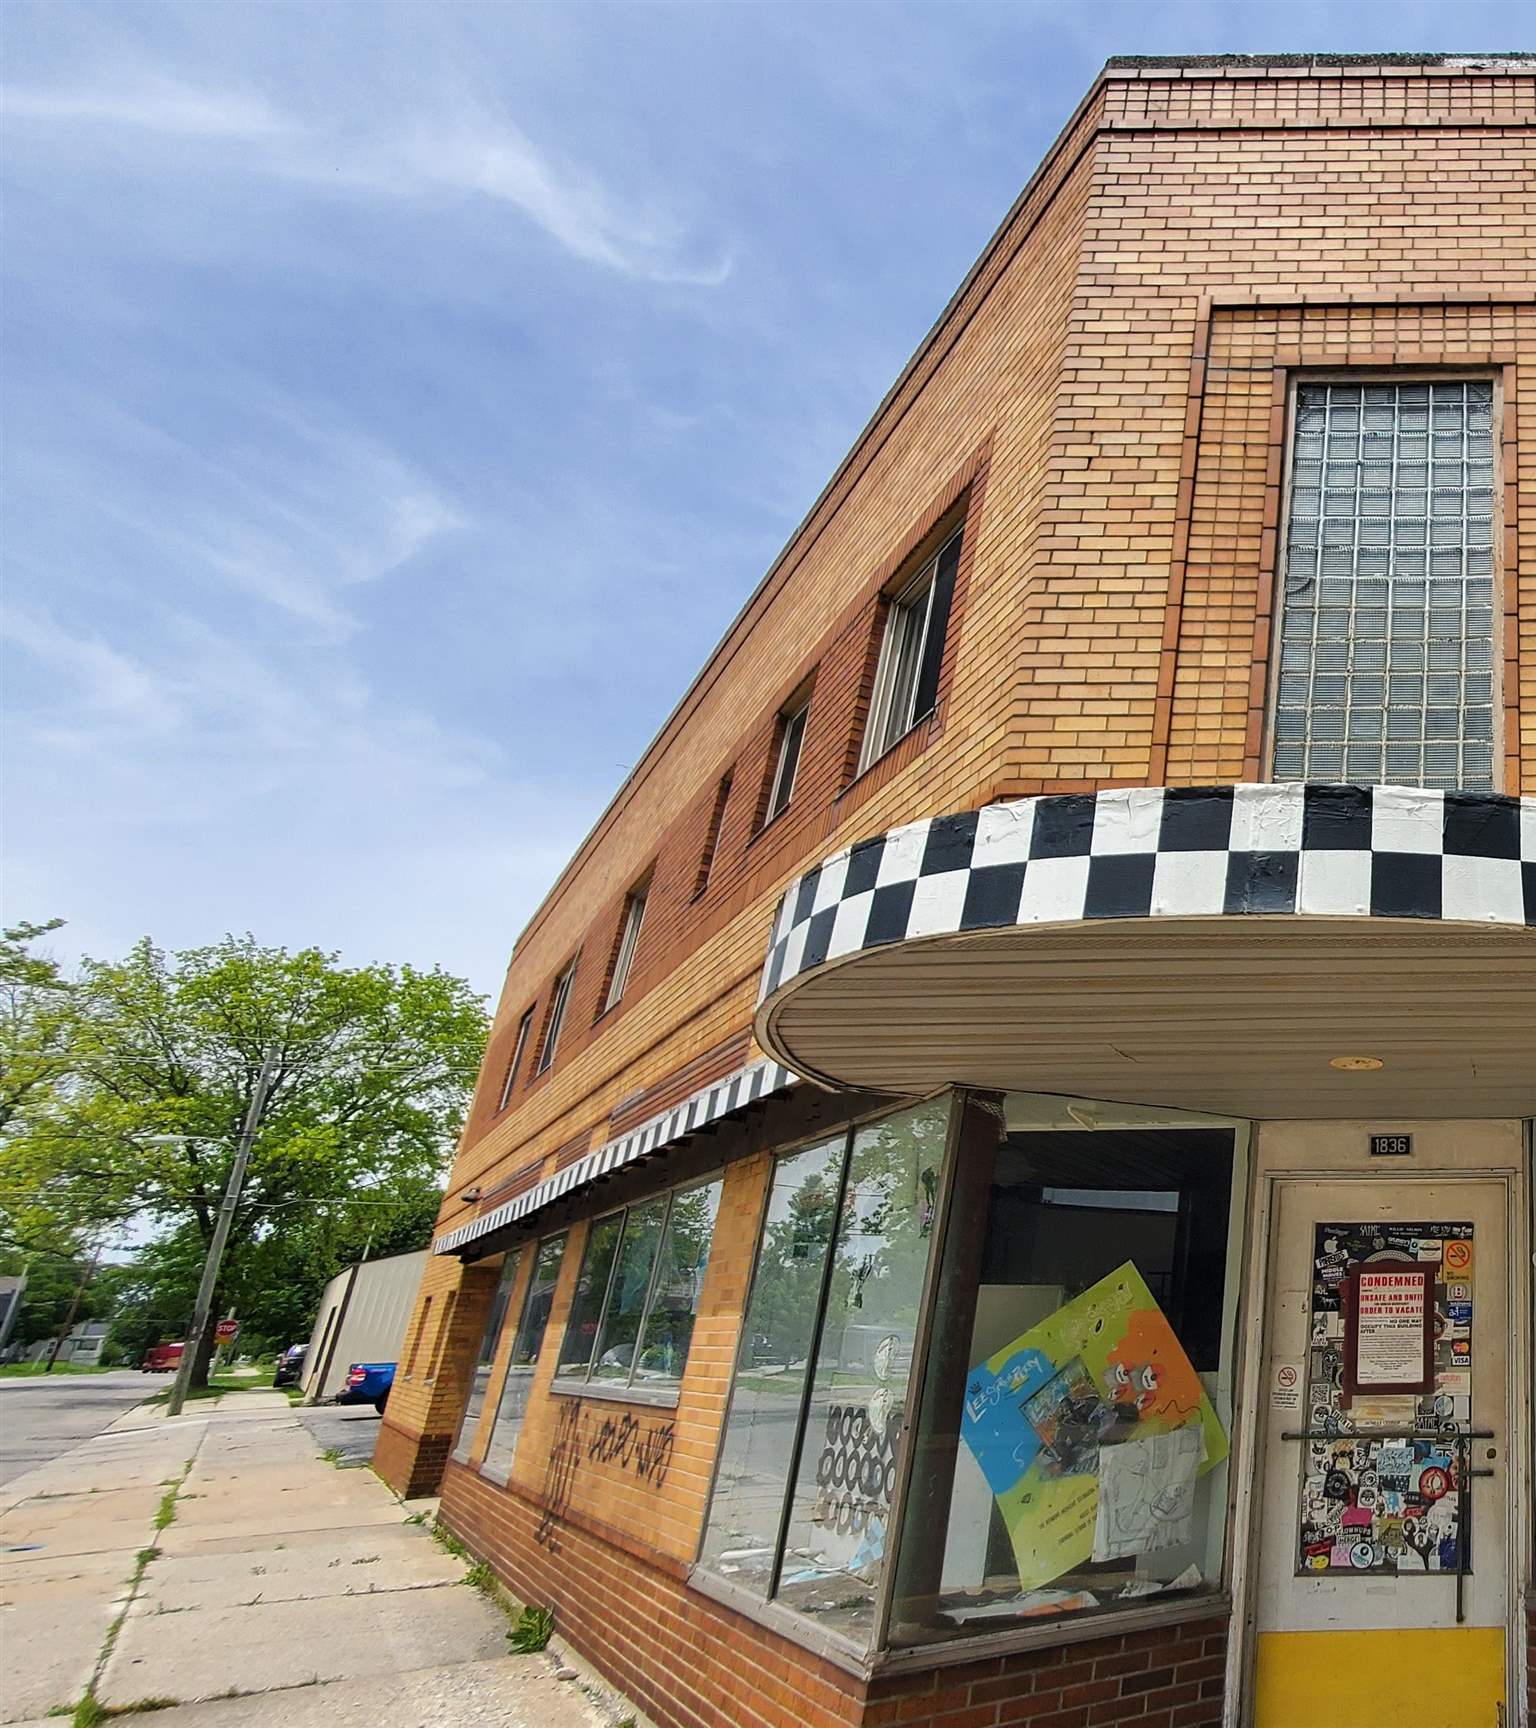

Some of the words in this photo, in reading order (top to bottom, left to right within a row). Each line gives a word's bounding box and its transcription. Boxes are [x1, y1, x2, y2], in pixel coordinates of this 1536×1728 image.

[1375, 1138, 1407, 1153] 1836
[1361, 1276, 1424, 1287] CONDEMNED
[1360, 1294, 1386, 1302] UNSAFE
[1388, 1294, 1403, 1302] AND
[1360, 1306, 1383, 1314] ORDER
